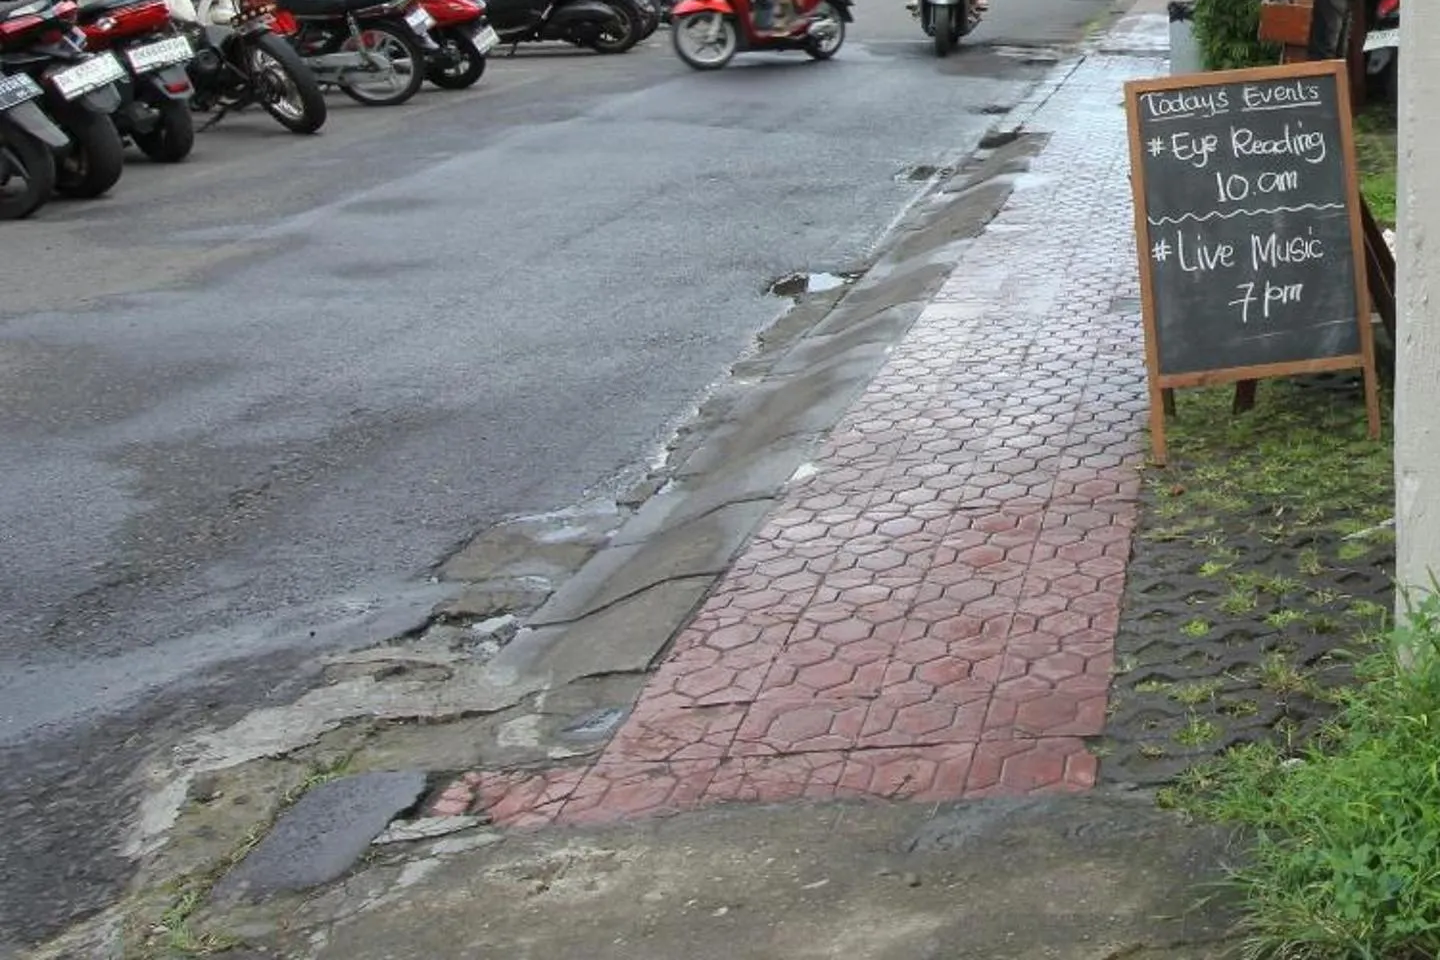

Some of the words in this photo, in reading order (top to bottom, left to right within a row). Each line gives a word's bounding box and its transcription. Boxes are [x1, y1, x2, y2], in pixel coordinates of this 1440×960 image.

[1243, 81, 1320, 108] Events
[1231, 121, 1326, 163] Reading
[1251, 226, 1324, 270] Music
